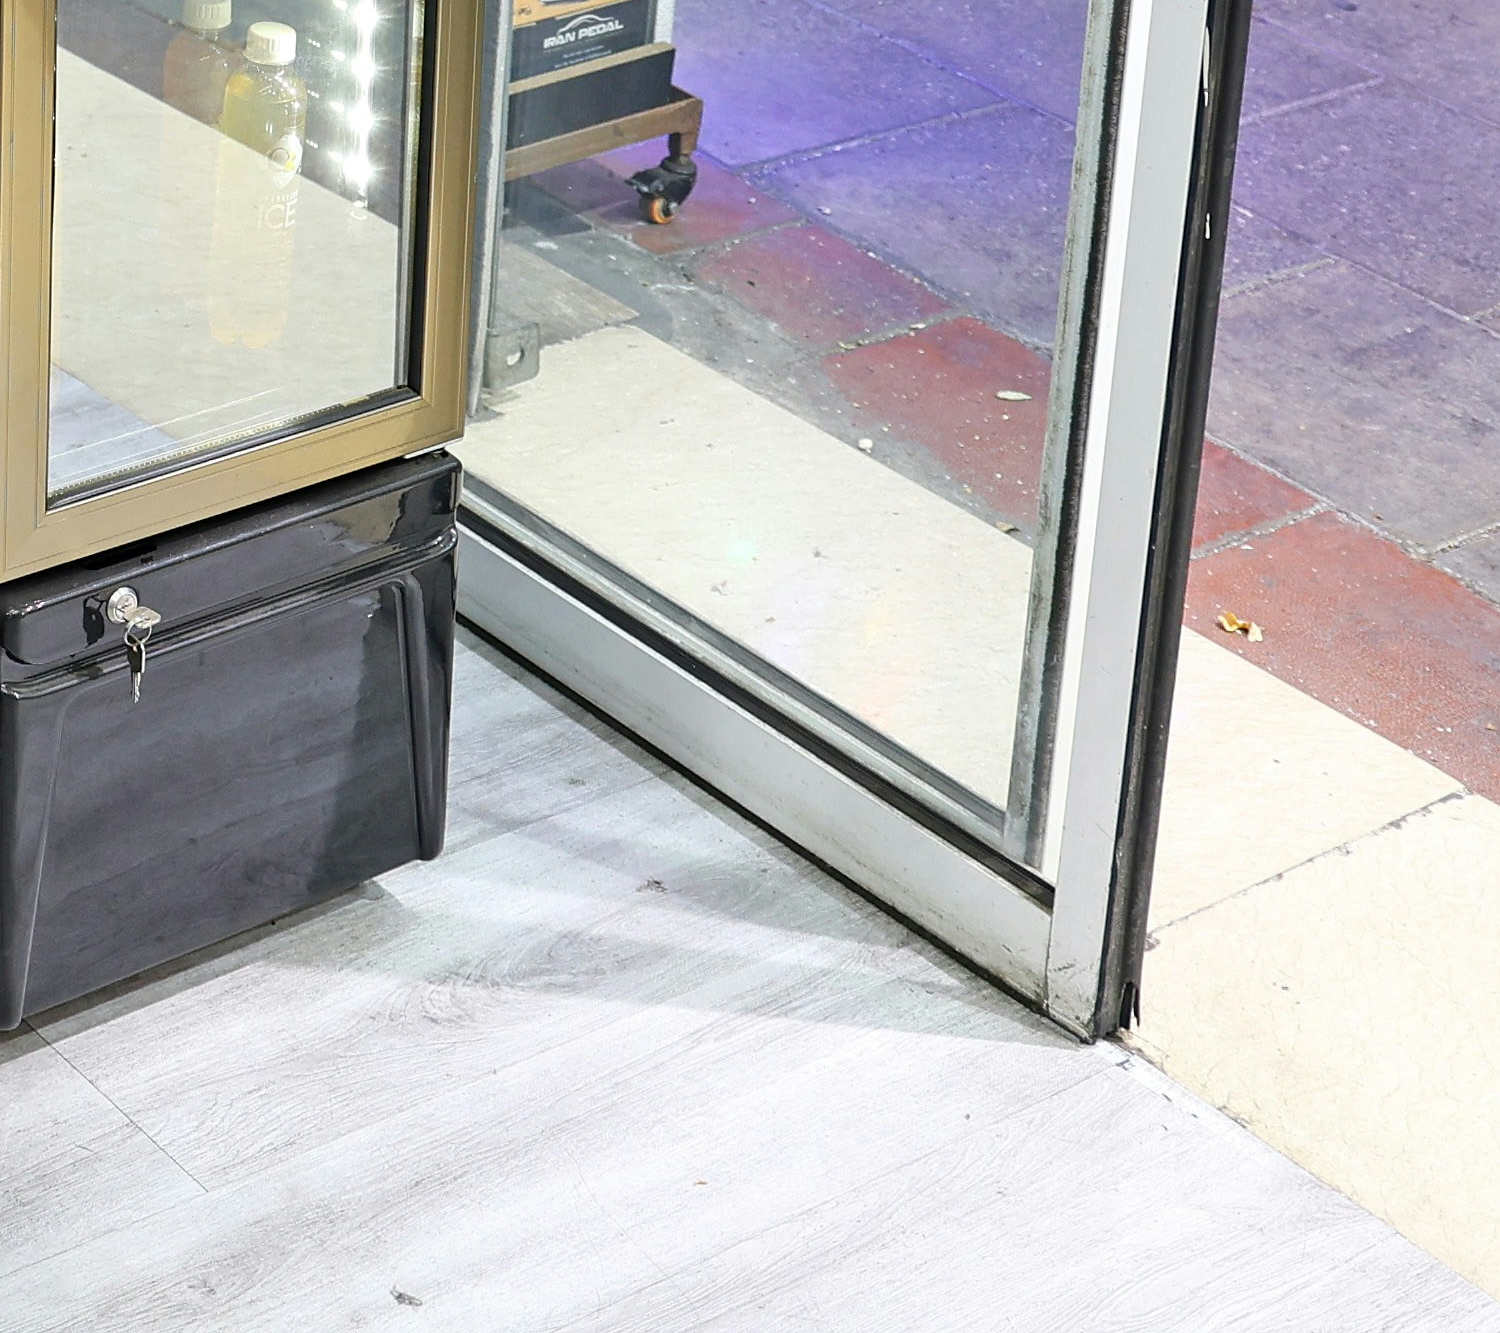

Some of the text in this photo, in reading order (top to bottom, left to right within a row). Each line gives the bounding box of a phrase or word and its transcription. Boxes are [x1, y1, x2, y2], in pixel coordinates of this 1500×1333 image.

[543, 19, 624, 50] IRAN PEDAL
[256, 200, 298, 230] ICE
